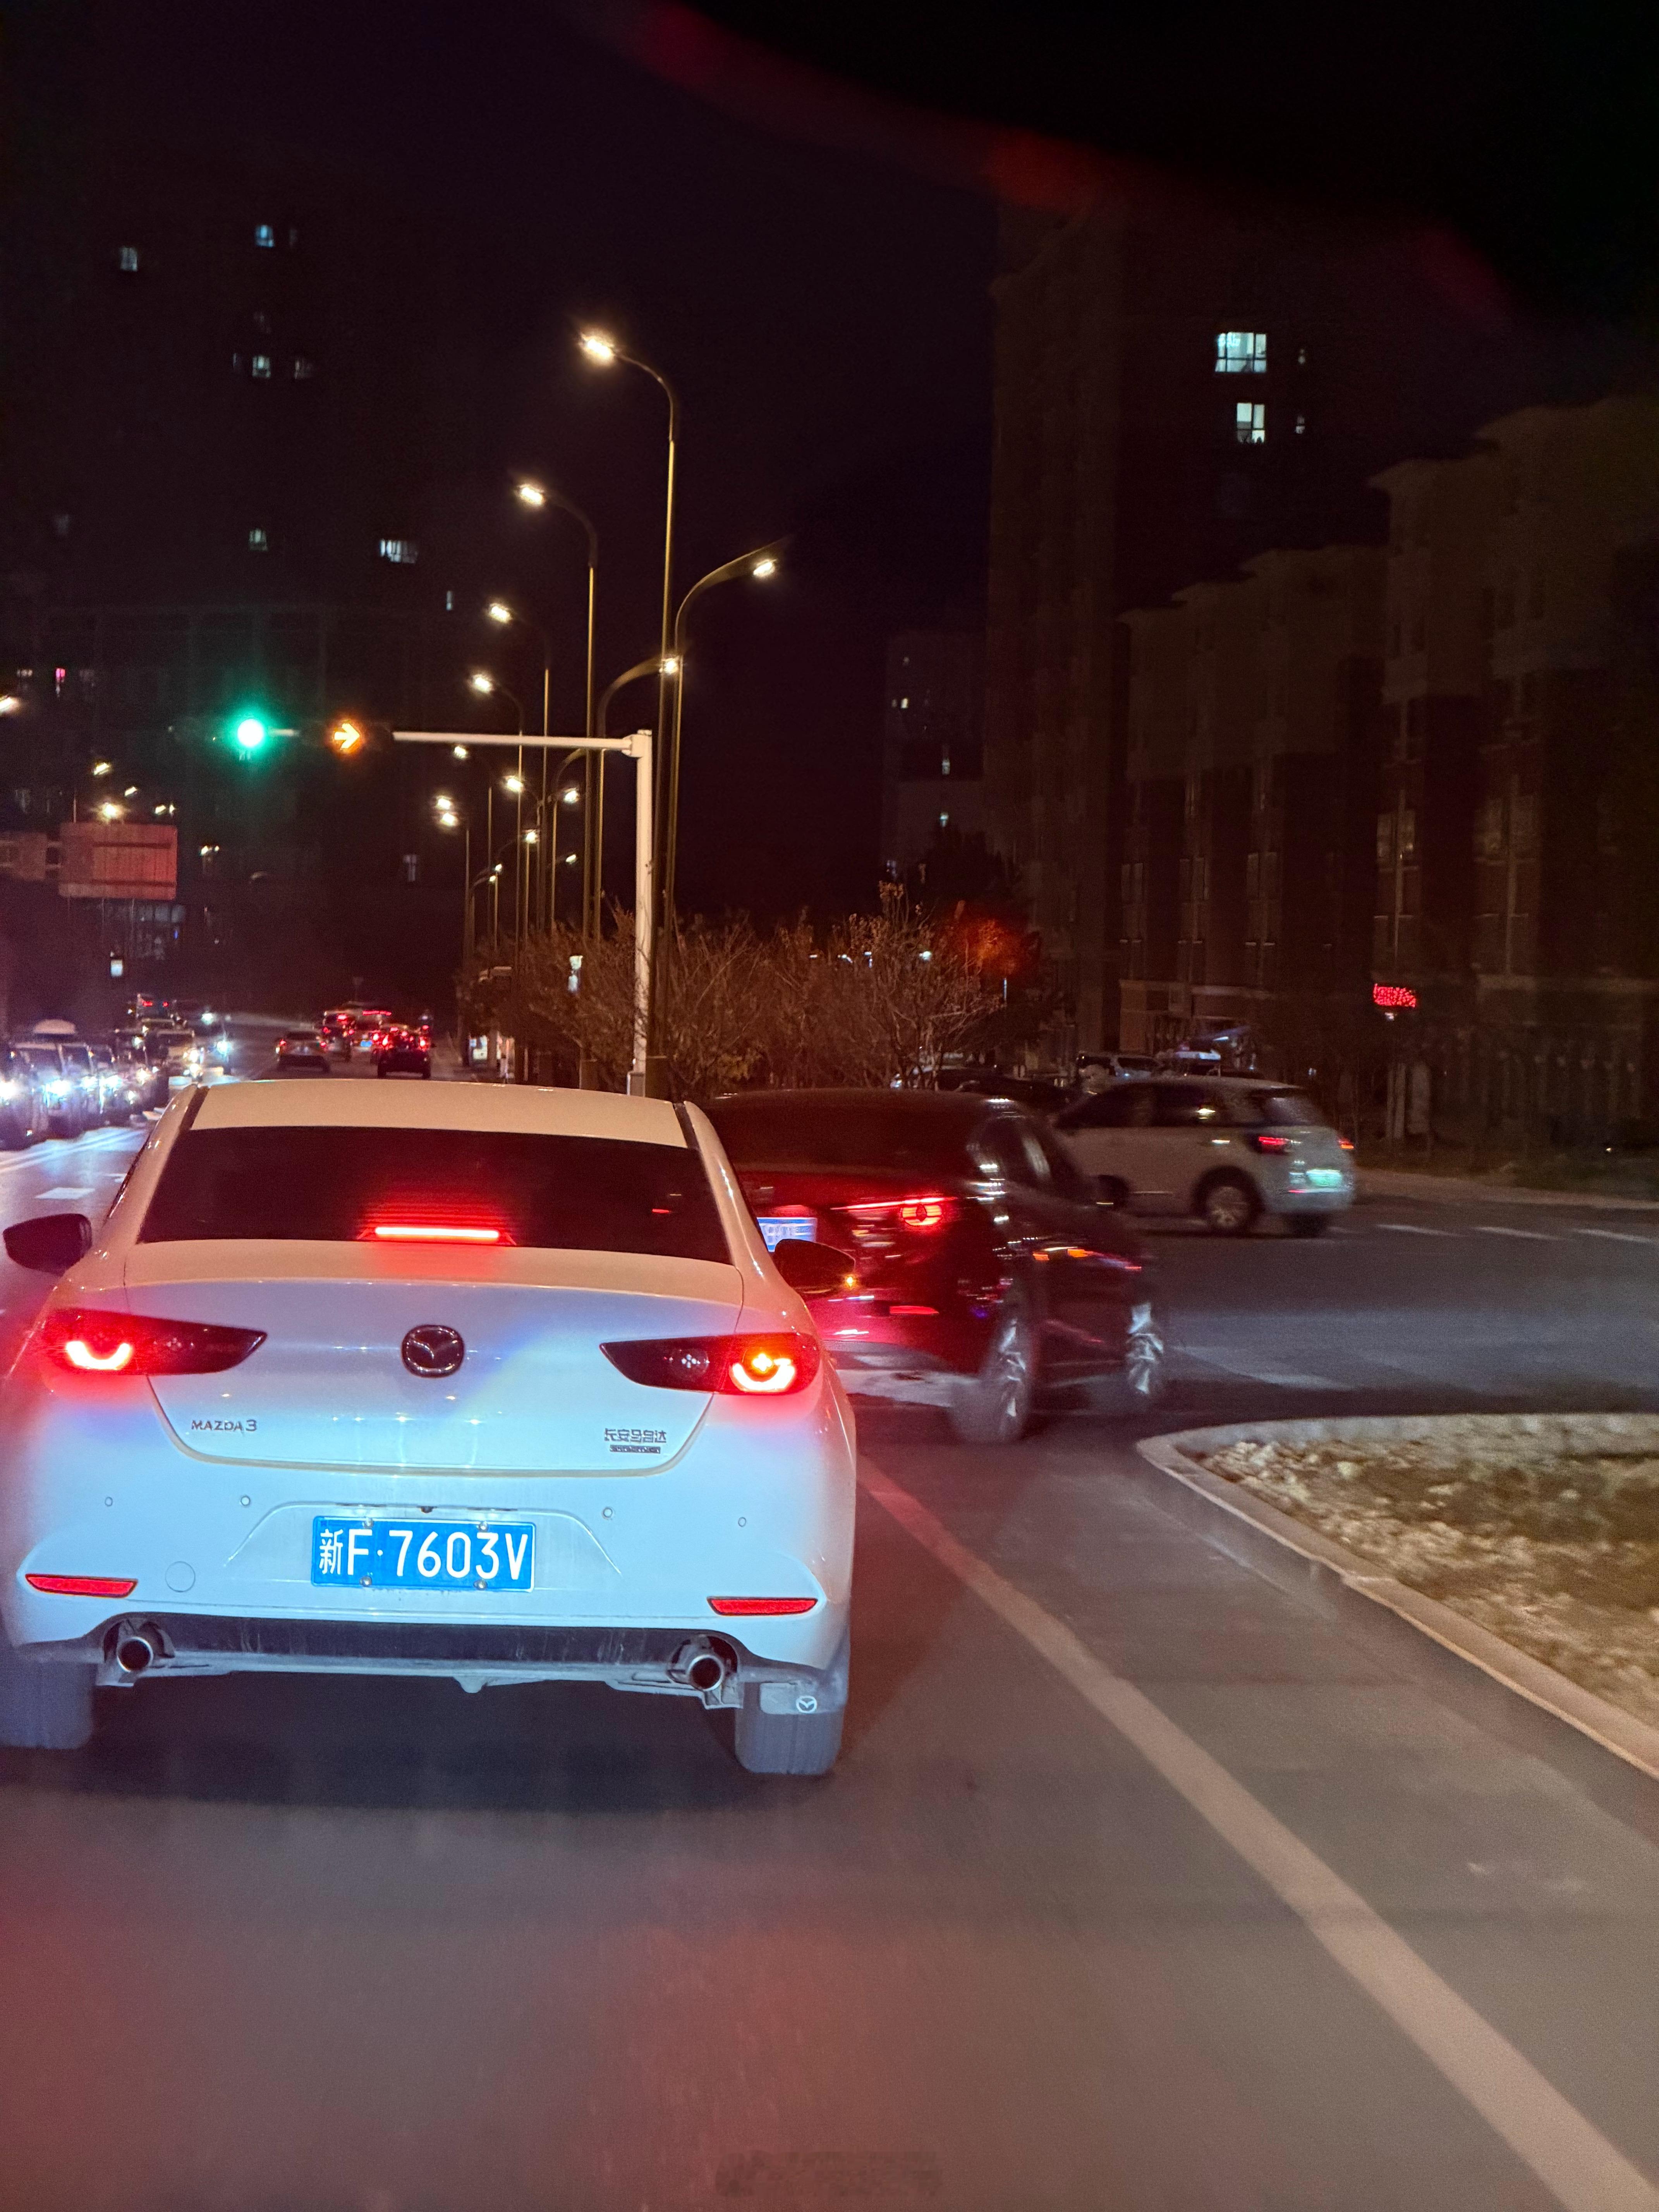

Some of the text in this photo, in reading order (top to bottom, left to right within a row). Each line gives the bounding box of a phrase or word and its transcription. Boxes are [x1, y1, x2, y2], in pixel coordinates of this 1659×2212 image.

[604, 1428, 666, 1443] 长安马自达
